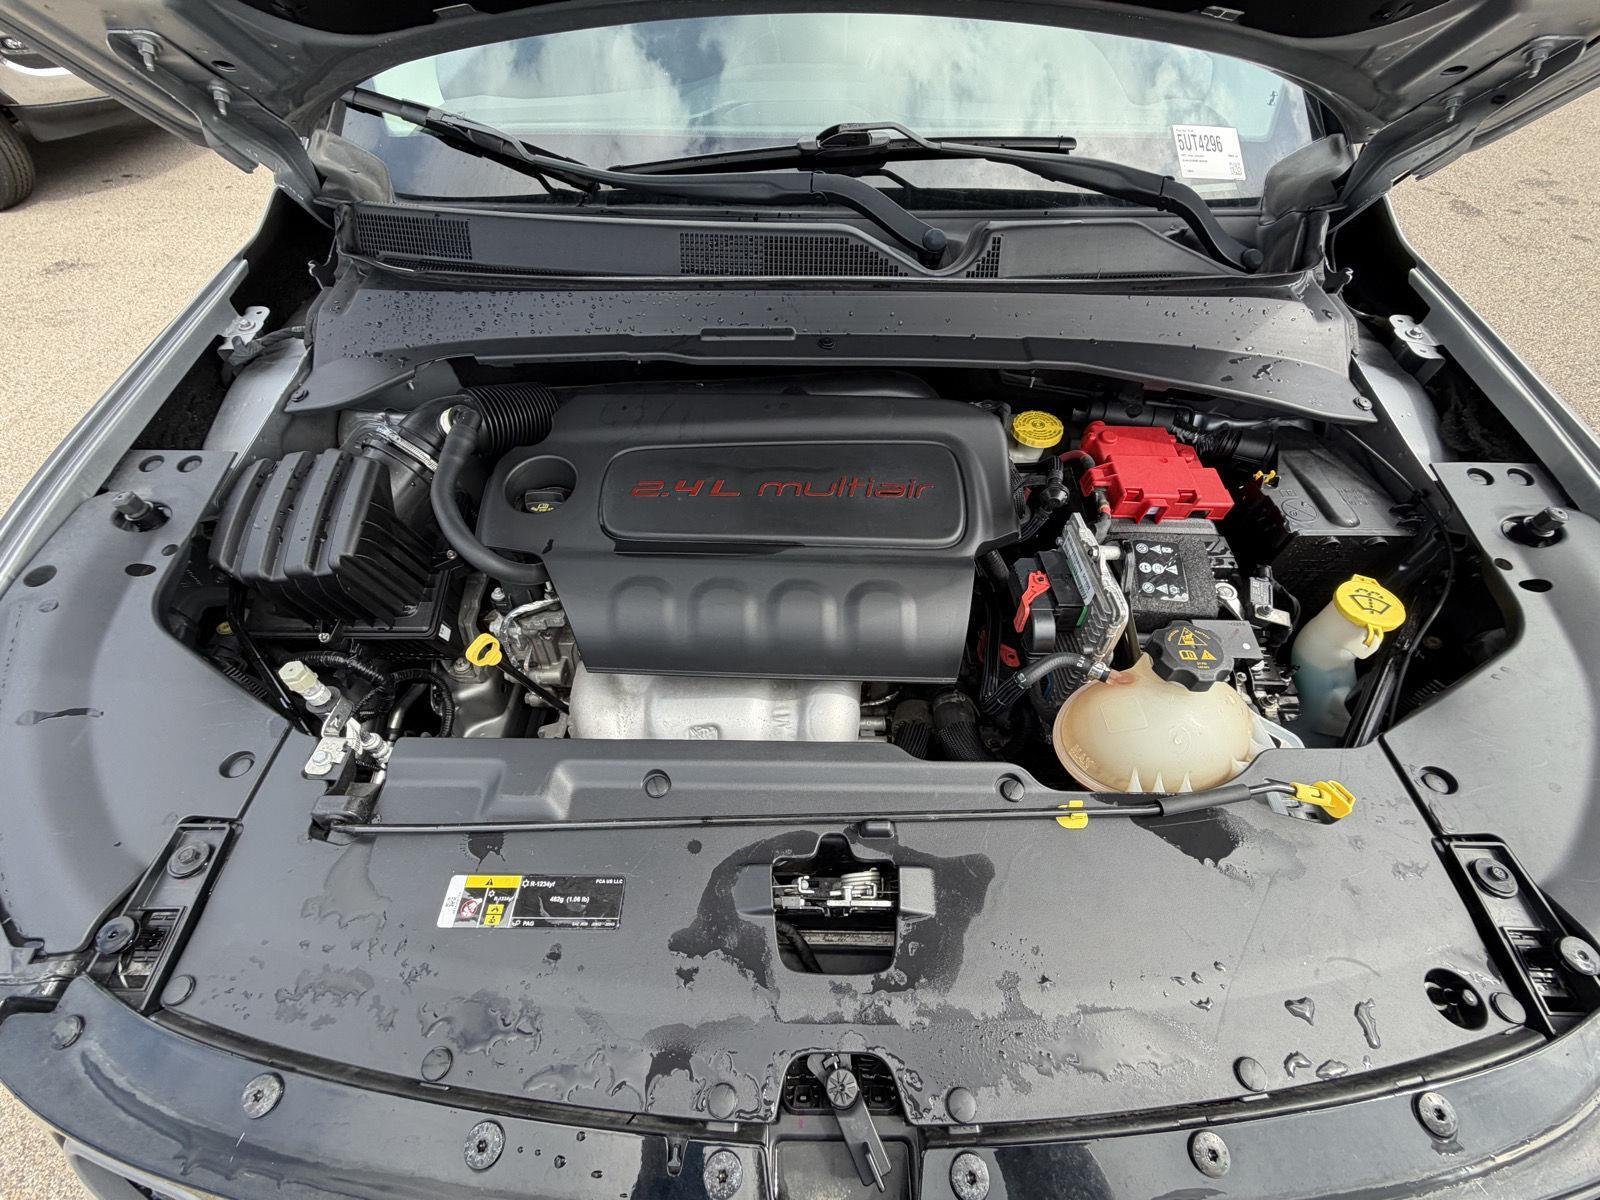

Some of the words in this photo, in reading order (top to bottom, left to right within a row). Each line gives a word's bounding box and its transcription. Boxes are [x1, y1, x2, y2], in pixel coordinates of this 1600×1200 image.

[1177, 133, 1223, 153] 5UT4296
[629, 479, 742, 498] 2.4L
[757, 474, 936, 499] multiair
